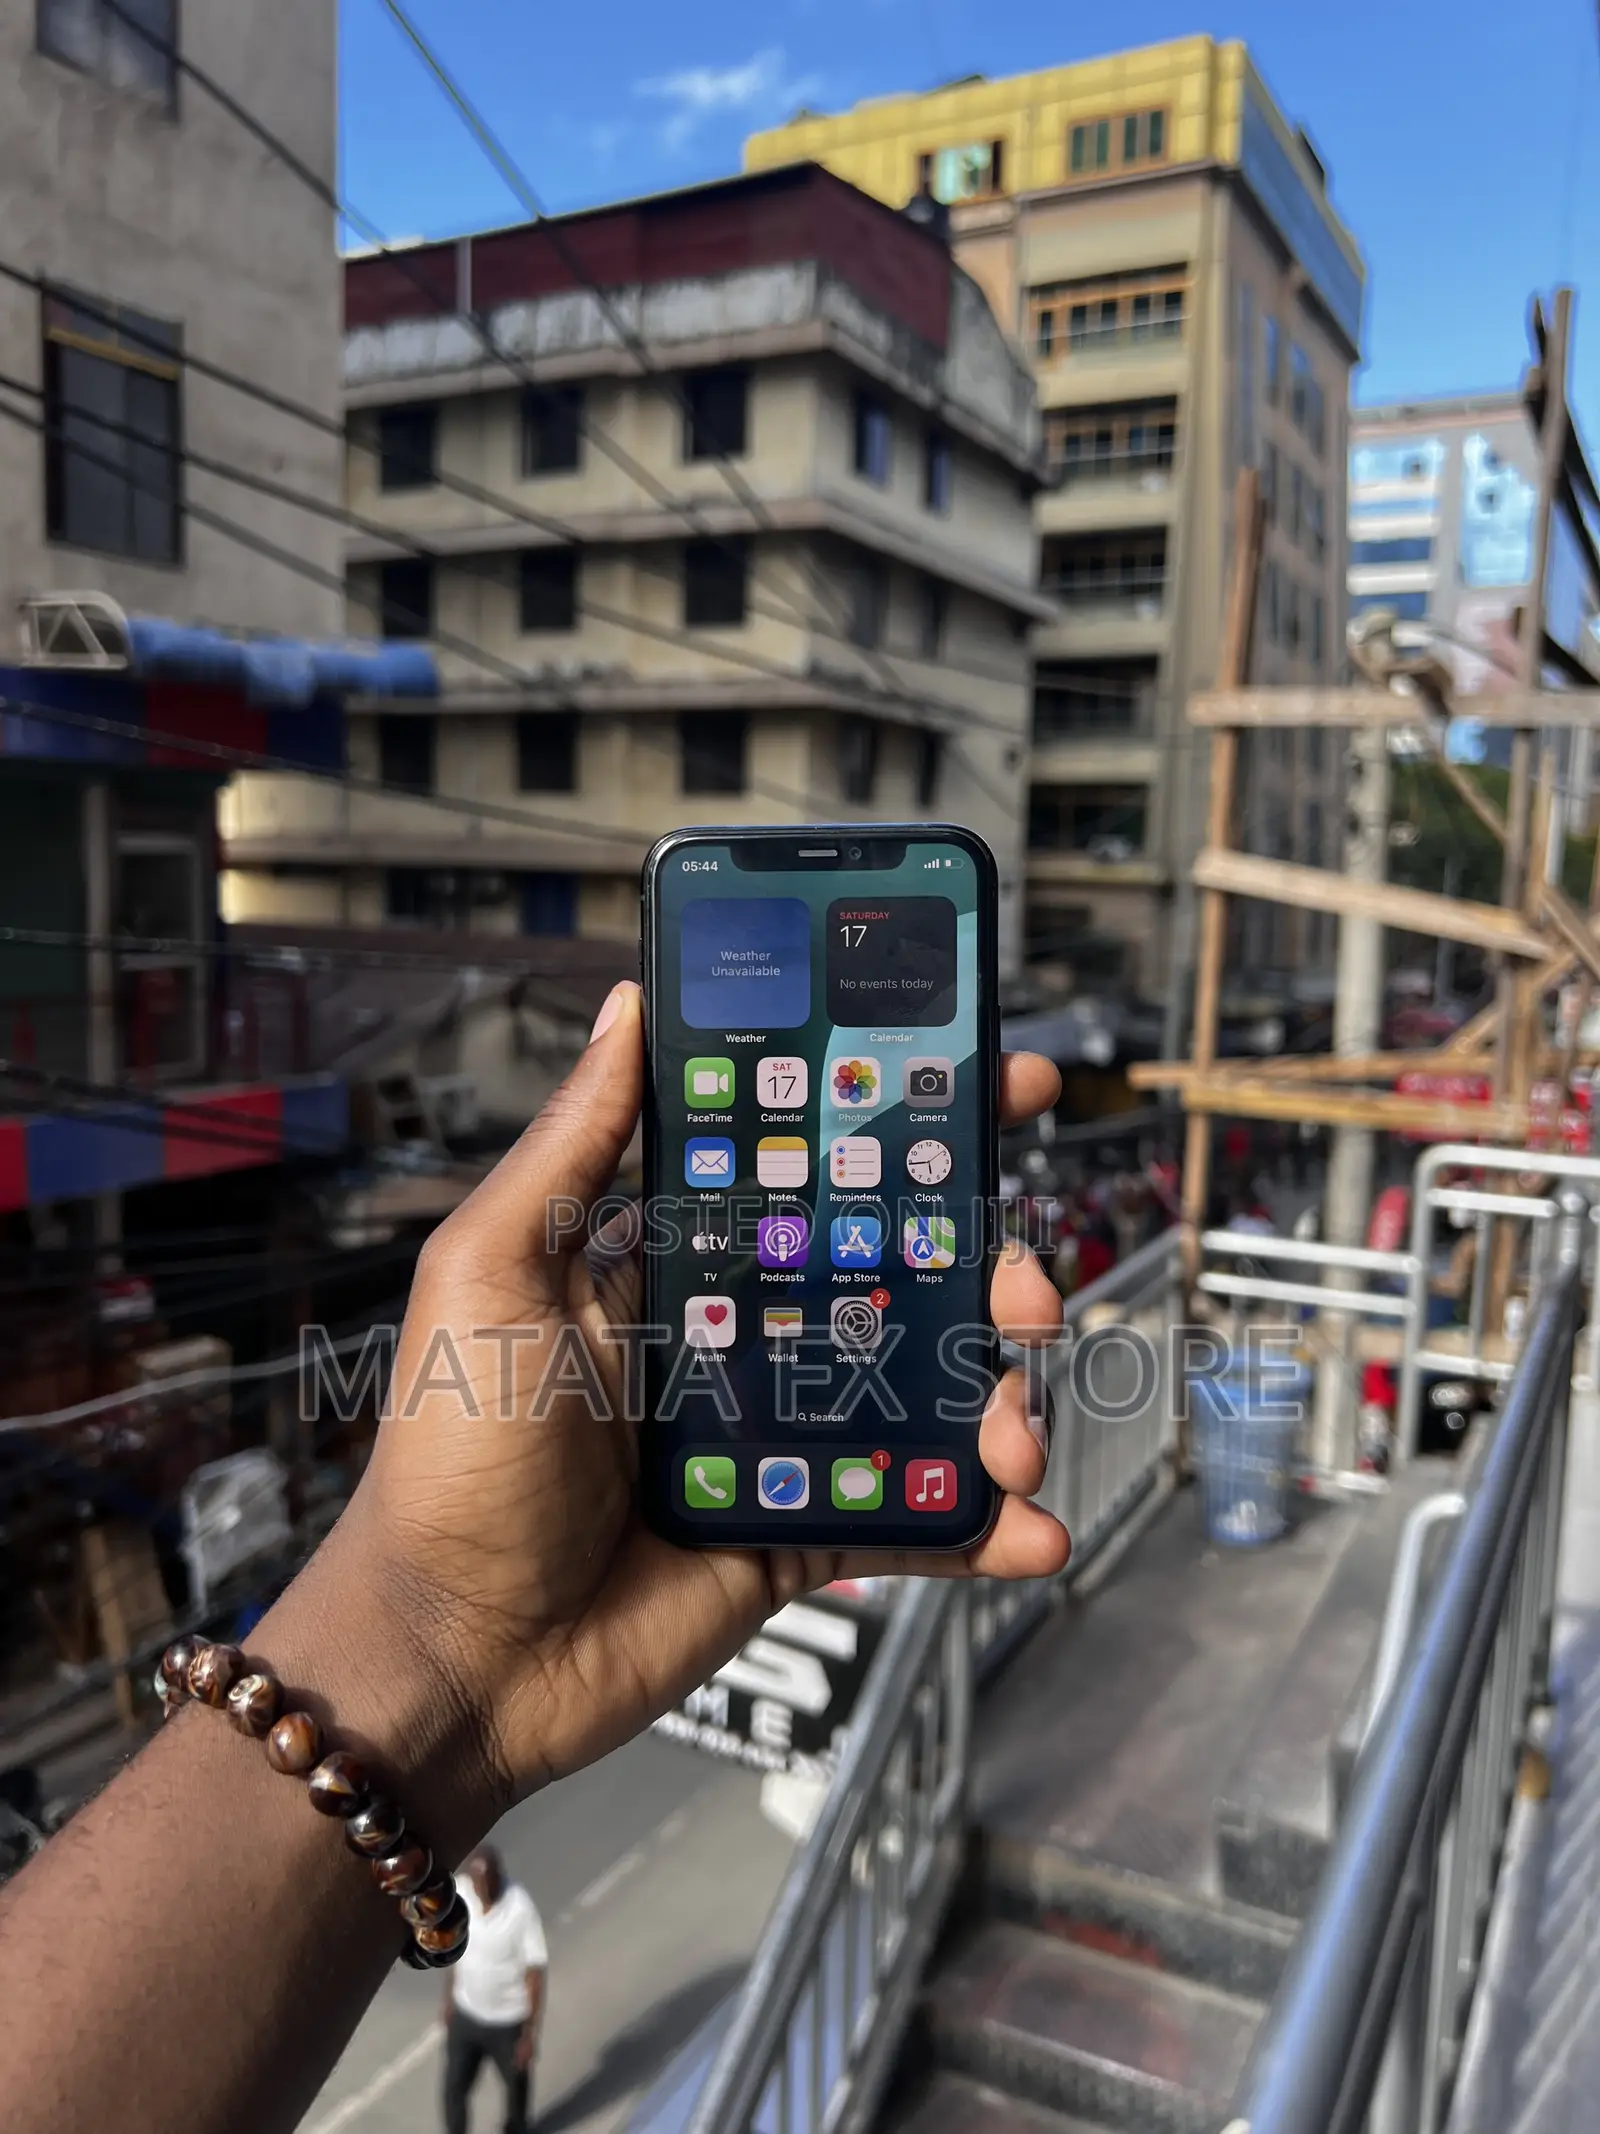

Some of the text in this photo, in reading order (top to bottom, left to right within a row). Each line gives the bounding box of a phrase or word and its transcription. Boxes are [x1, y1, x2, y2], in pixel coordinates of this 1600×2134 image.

[682, 860, 719, 872] 05:44
[839, 911, 890, 920] SATURDAY
[839, 924, 868, 948] 17
[720, 950, 771, 961] Weather
[711, 965, 781, 977] Unavailable
[839, 978, 934, 991] No events today
[725, 1033, 766, 1043] Weather
[869, 1032, 914, 1043] Calendar
[772, 1062, 792, 1072] SAT
[766, 1075, 797, 1100] 17
[687, 1113, 733, 1123] FaceTime
[760, 1113, 804, 1123] Calendar
[838, 1113, 872, 1123] Photos
[909, 1113, 948, 1123] Camera
[699, 1193, 720, 1203] Mail
[768, 1193, 797, 1203] Notes
[830, 1193, 882, 1203] Reminders
[915, 1193, 943, 1203] Clock
[708, 1233, 729, 1250] tv
[703, 1273, 718, 1282] TV
[760, 1273, 805, 1283] Podcasts
[832, 1273, 881, 1285] App Store
[916, 1273, 943, 1285] Maps
[876, 1293, 885, 1304] 2
[694, 1353, 726, 1363] Health
[768, 1353, 799, 1363] Wallet
[836, 1353, 877, 1365] Settings
[810, 1412, 844, 1422] Search
[877, 1455, 884, 1466] 1
